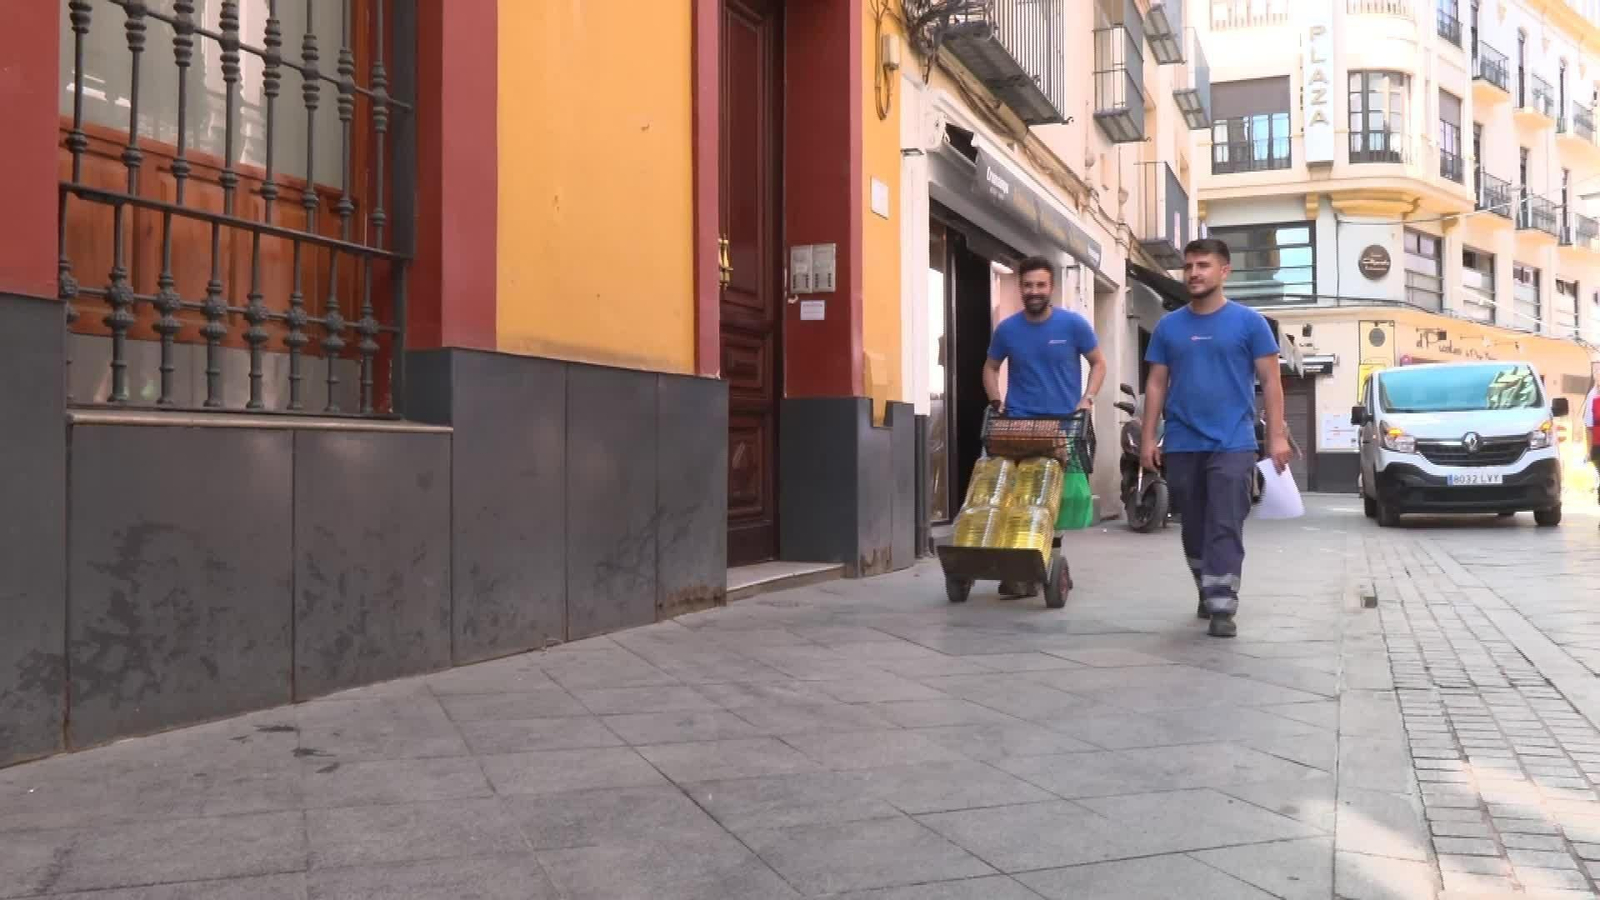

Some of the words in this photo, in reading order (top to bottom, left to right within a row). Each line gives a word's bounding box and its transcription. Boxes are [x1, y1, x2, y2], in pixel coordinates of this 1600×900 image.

[1309, 25, 1328, 127] PLAZA
[1453, 474, 1477, 484] 8032
[1481, 474, 1499, 483] LVY
